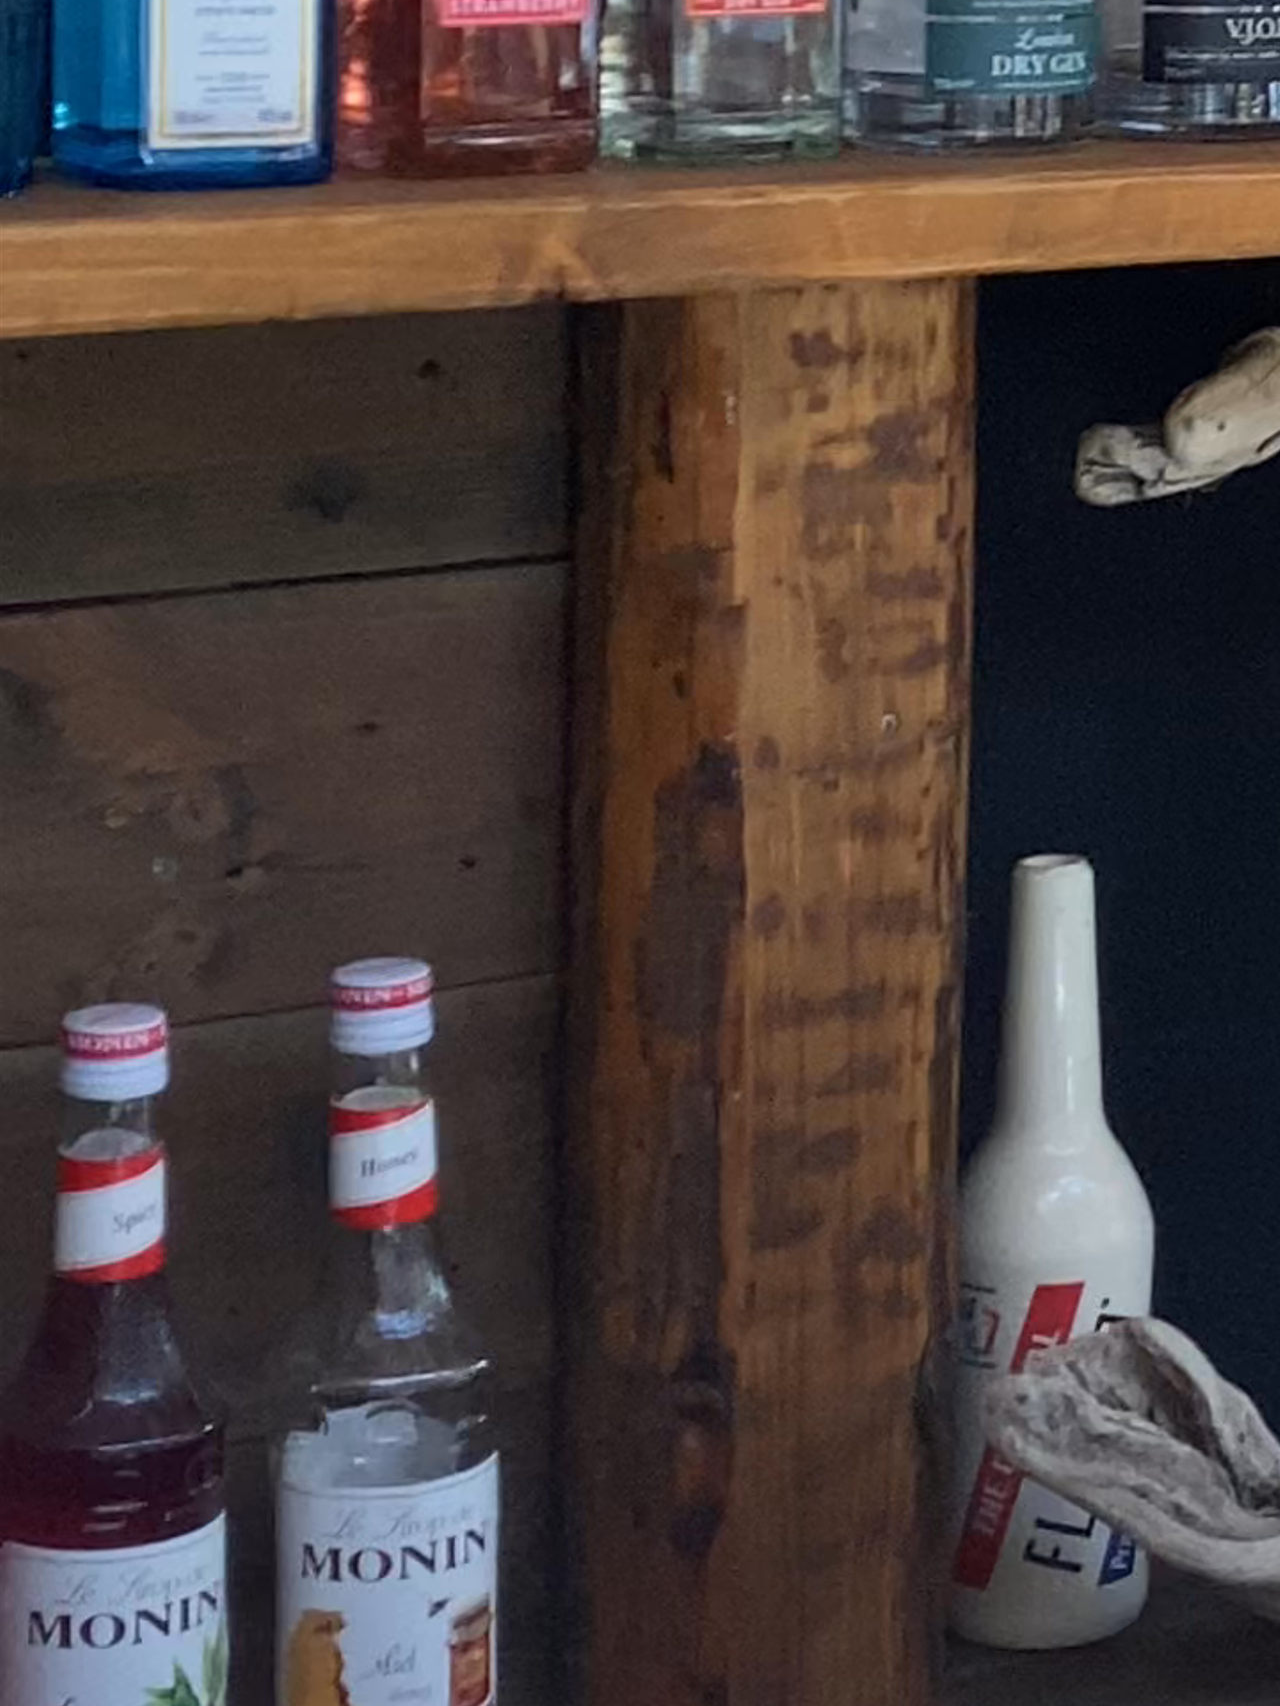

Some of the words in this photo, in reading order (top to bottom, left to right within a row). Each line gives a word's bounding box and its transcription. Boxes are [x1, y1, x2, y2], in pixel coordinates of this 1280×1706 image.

[987, 52, 1043, 77] DRY
[301, 1528, 487, 1584] MONIN
[28, 1589, 218, 1650] MONIN
